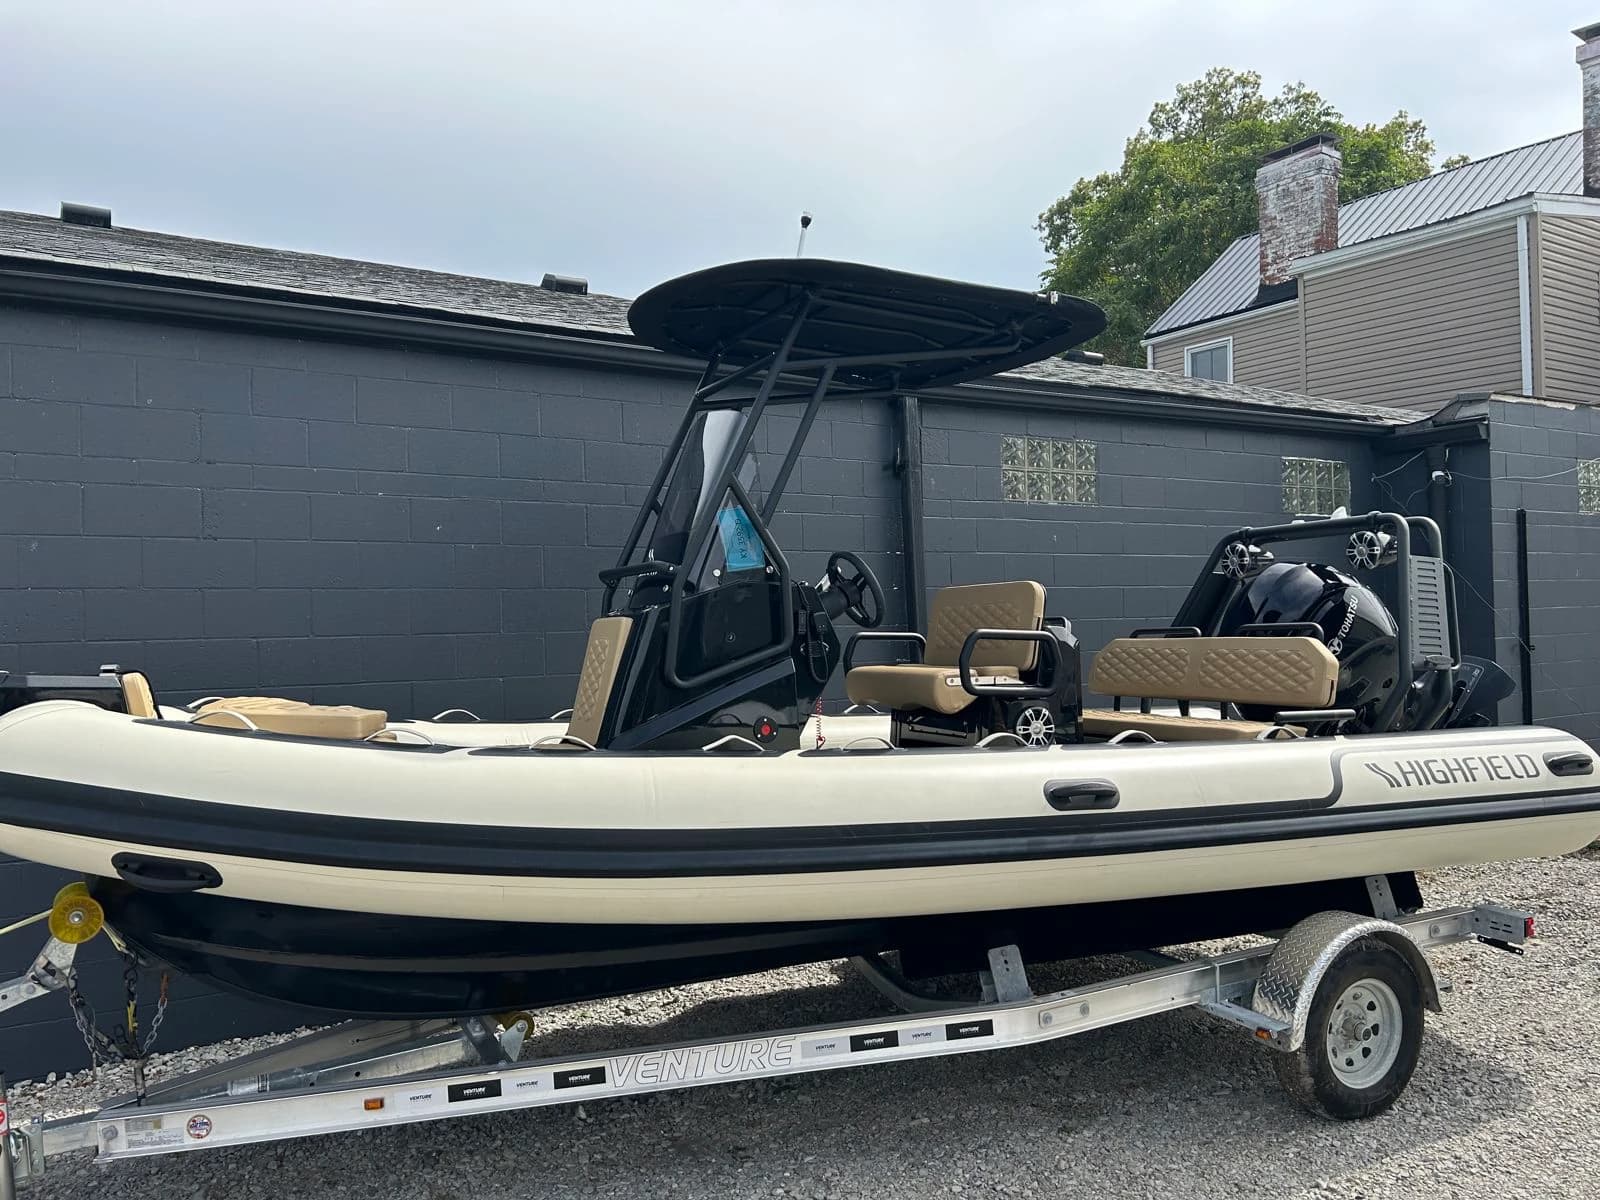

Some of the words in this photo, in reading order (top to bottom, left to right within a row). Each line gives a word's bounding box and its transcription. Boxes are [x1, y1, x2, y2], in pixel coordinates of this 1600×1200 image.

[1340, 596, 1359, 638] TOHATSU
[1394, 753, 1541, 787] HIGHFIELD
[959, 1026, 980, 1034] VENTURE
[911, 1031, 933, 1039] VENTURE
[863, 1037, 885, 1045] VENTURE
[815, 1043, 836, 1051] VENTURE
[608, 1036, 797, 1089] VENTURE
